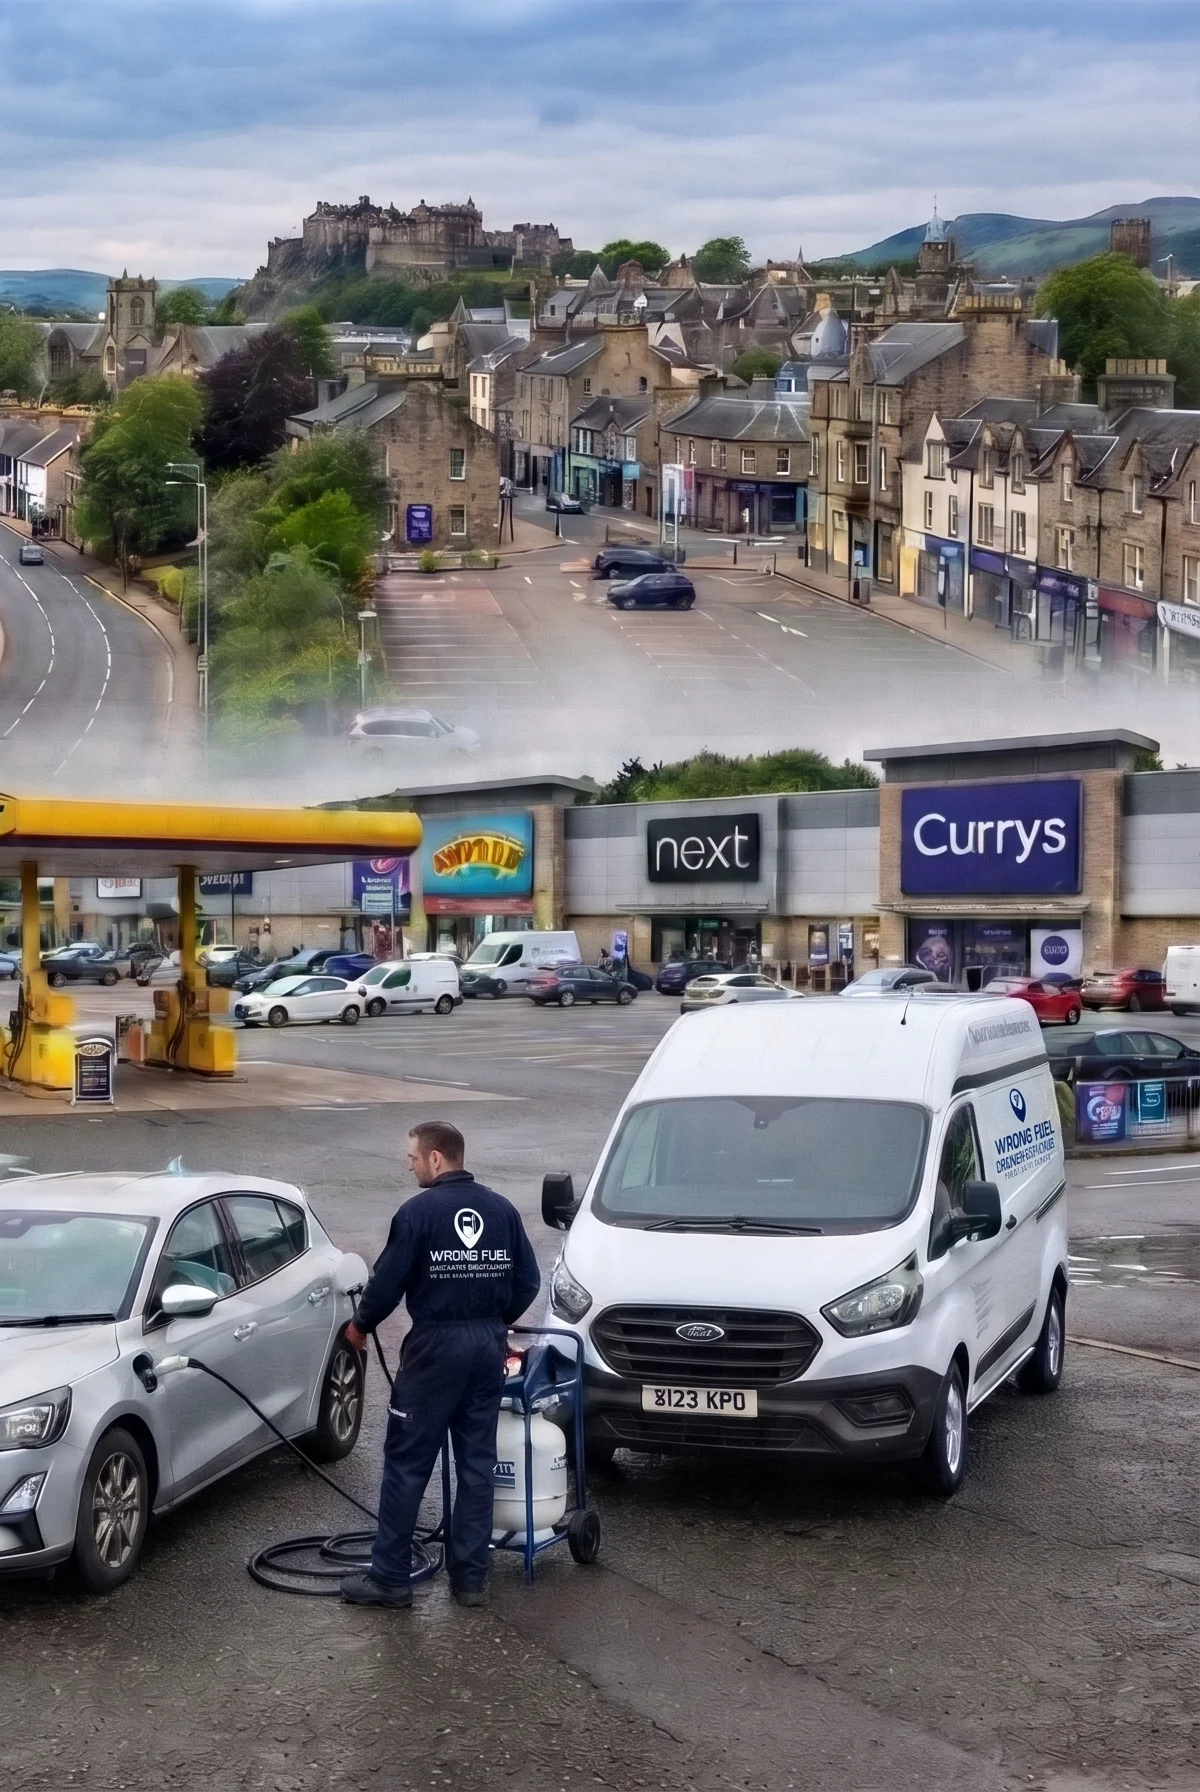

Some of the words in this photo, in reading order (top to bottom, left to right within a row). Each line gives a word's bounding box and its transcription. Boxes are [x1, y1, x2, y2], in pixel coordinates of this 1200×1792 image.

[656, 825, 750, 872] next
[913, 813, 1067, 864] Currys
[994, 1127, 1033, 1156] WRONG
[429, 1250, 479, 1262] WRONG
[481, 1249, 511, 1261] FUEL
